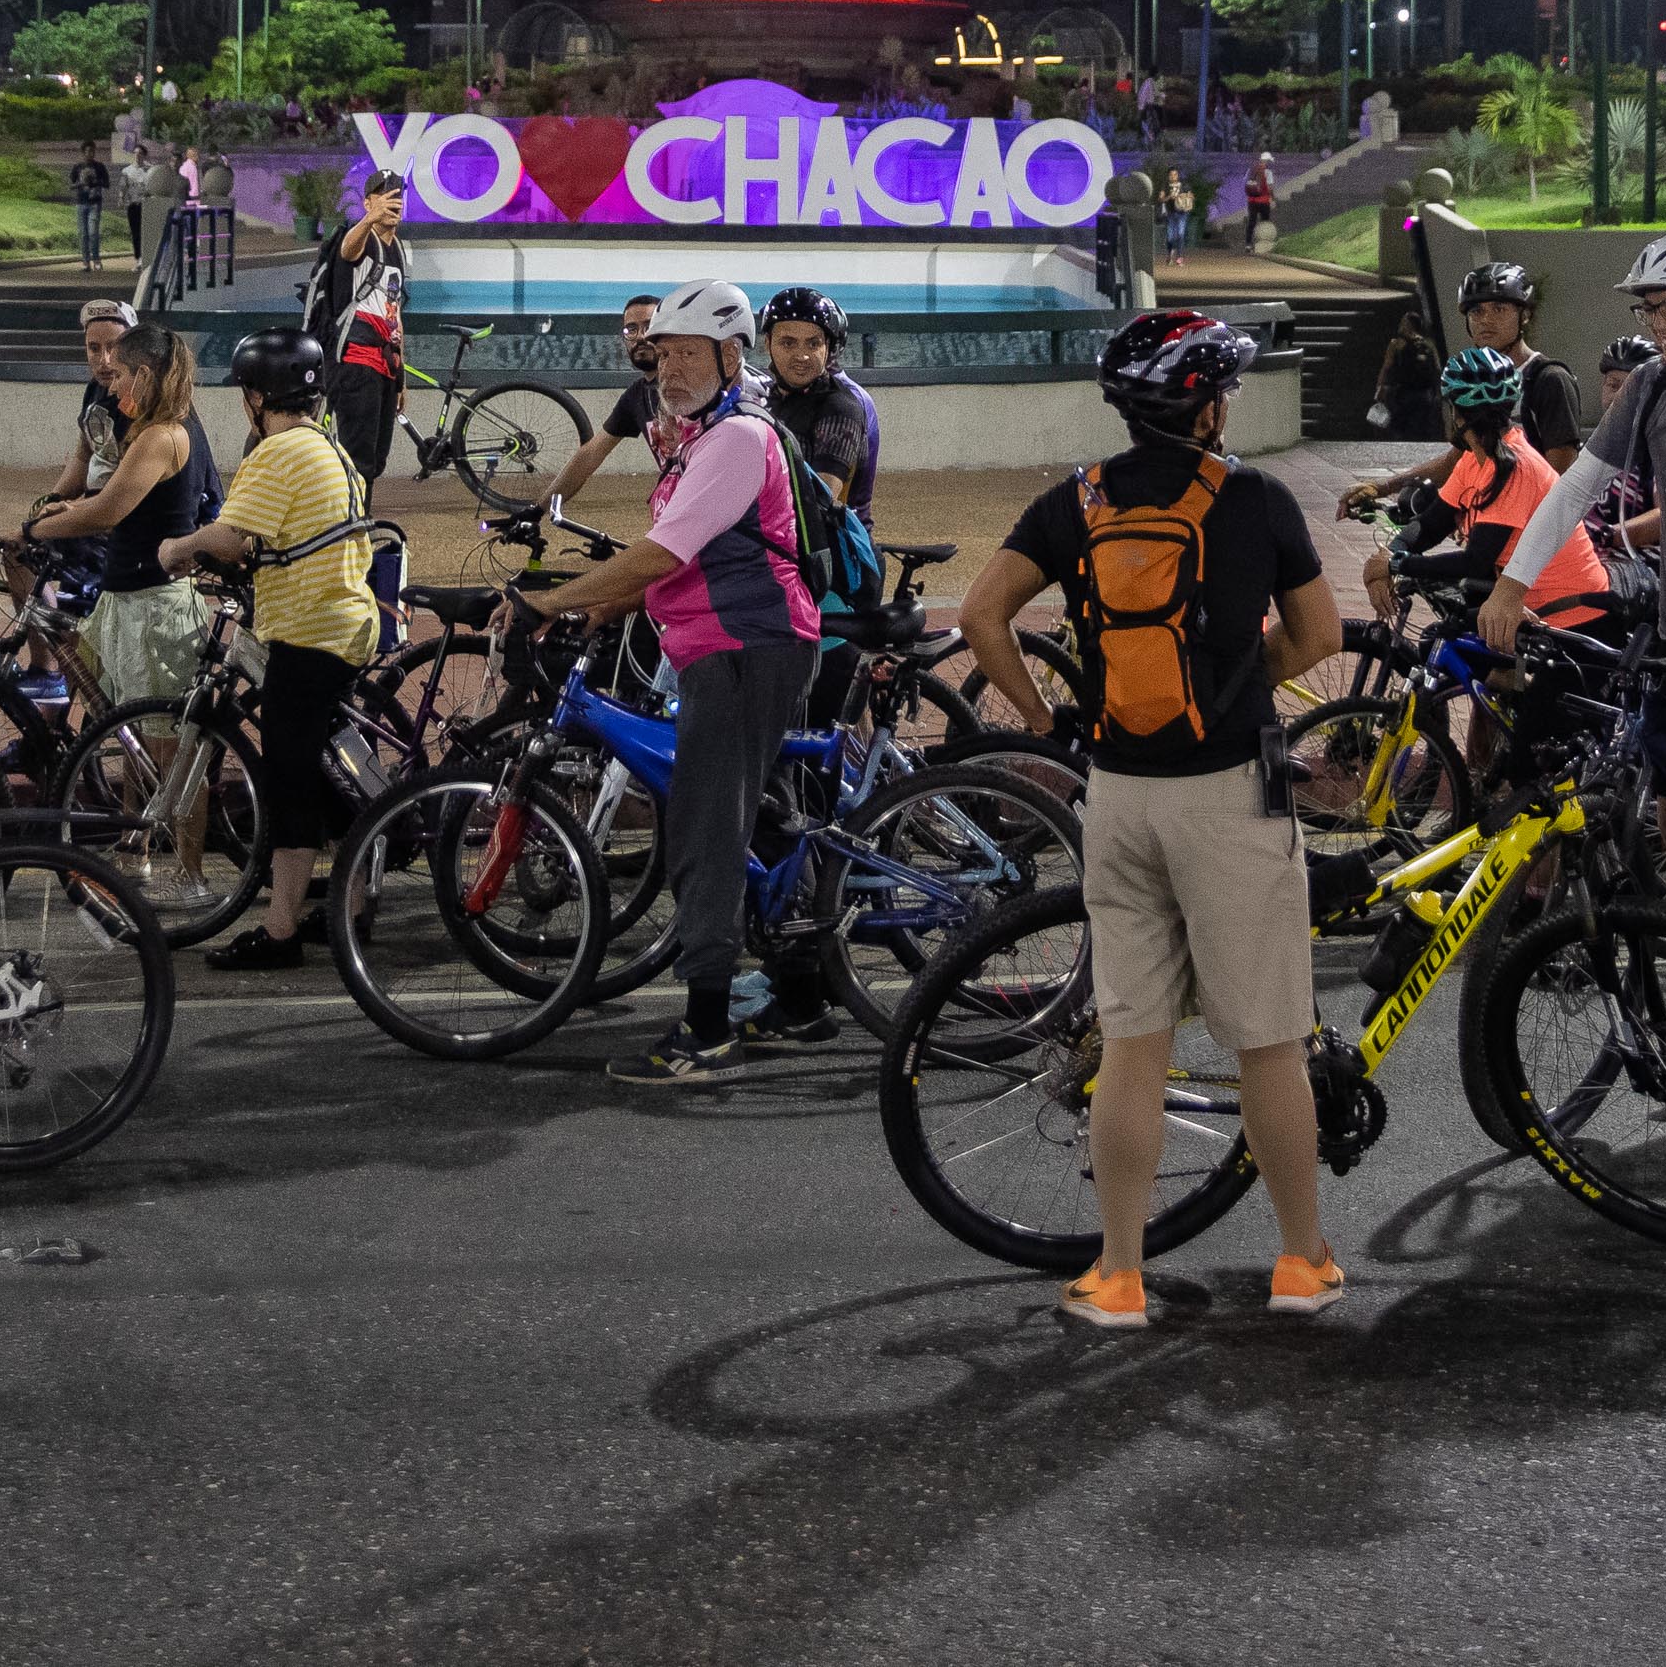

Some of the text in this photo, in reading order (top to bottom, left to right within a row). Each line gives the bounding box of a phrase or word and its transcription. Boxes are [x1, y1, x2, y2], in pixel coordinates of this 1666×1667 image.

[352, 112, 1115, 227] YO CHACAO
[784, 729, 831, 743] EK
[1524, 1126, 1604, 1200] MAXXIS
